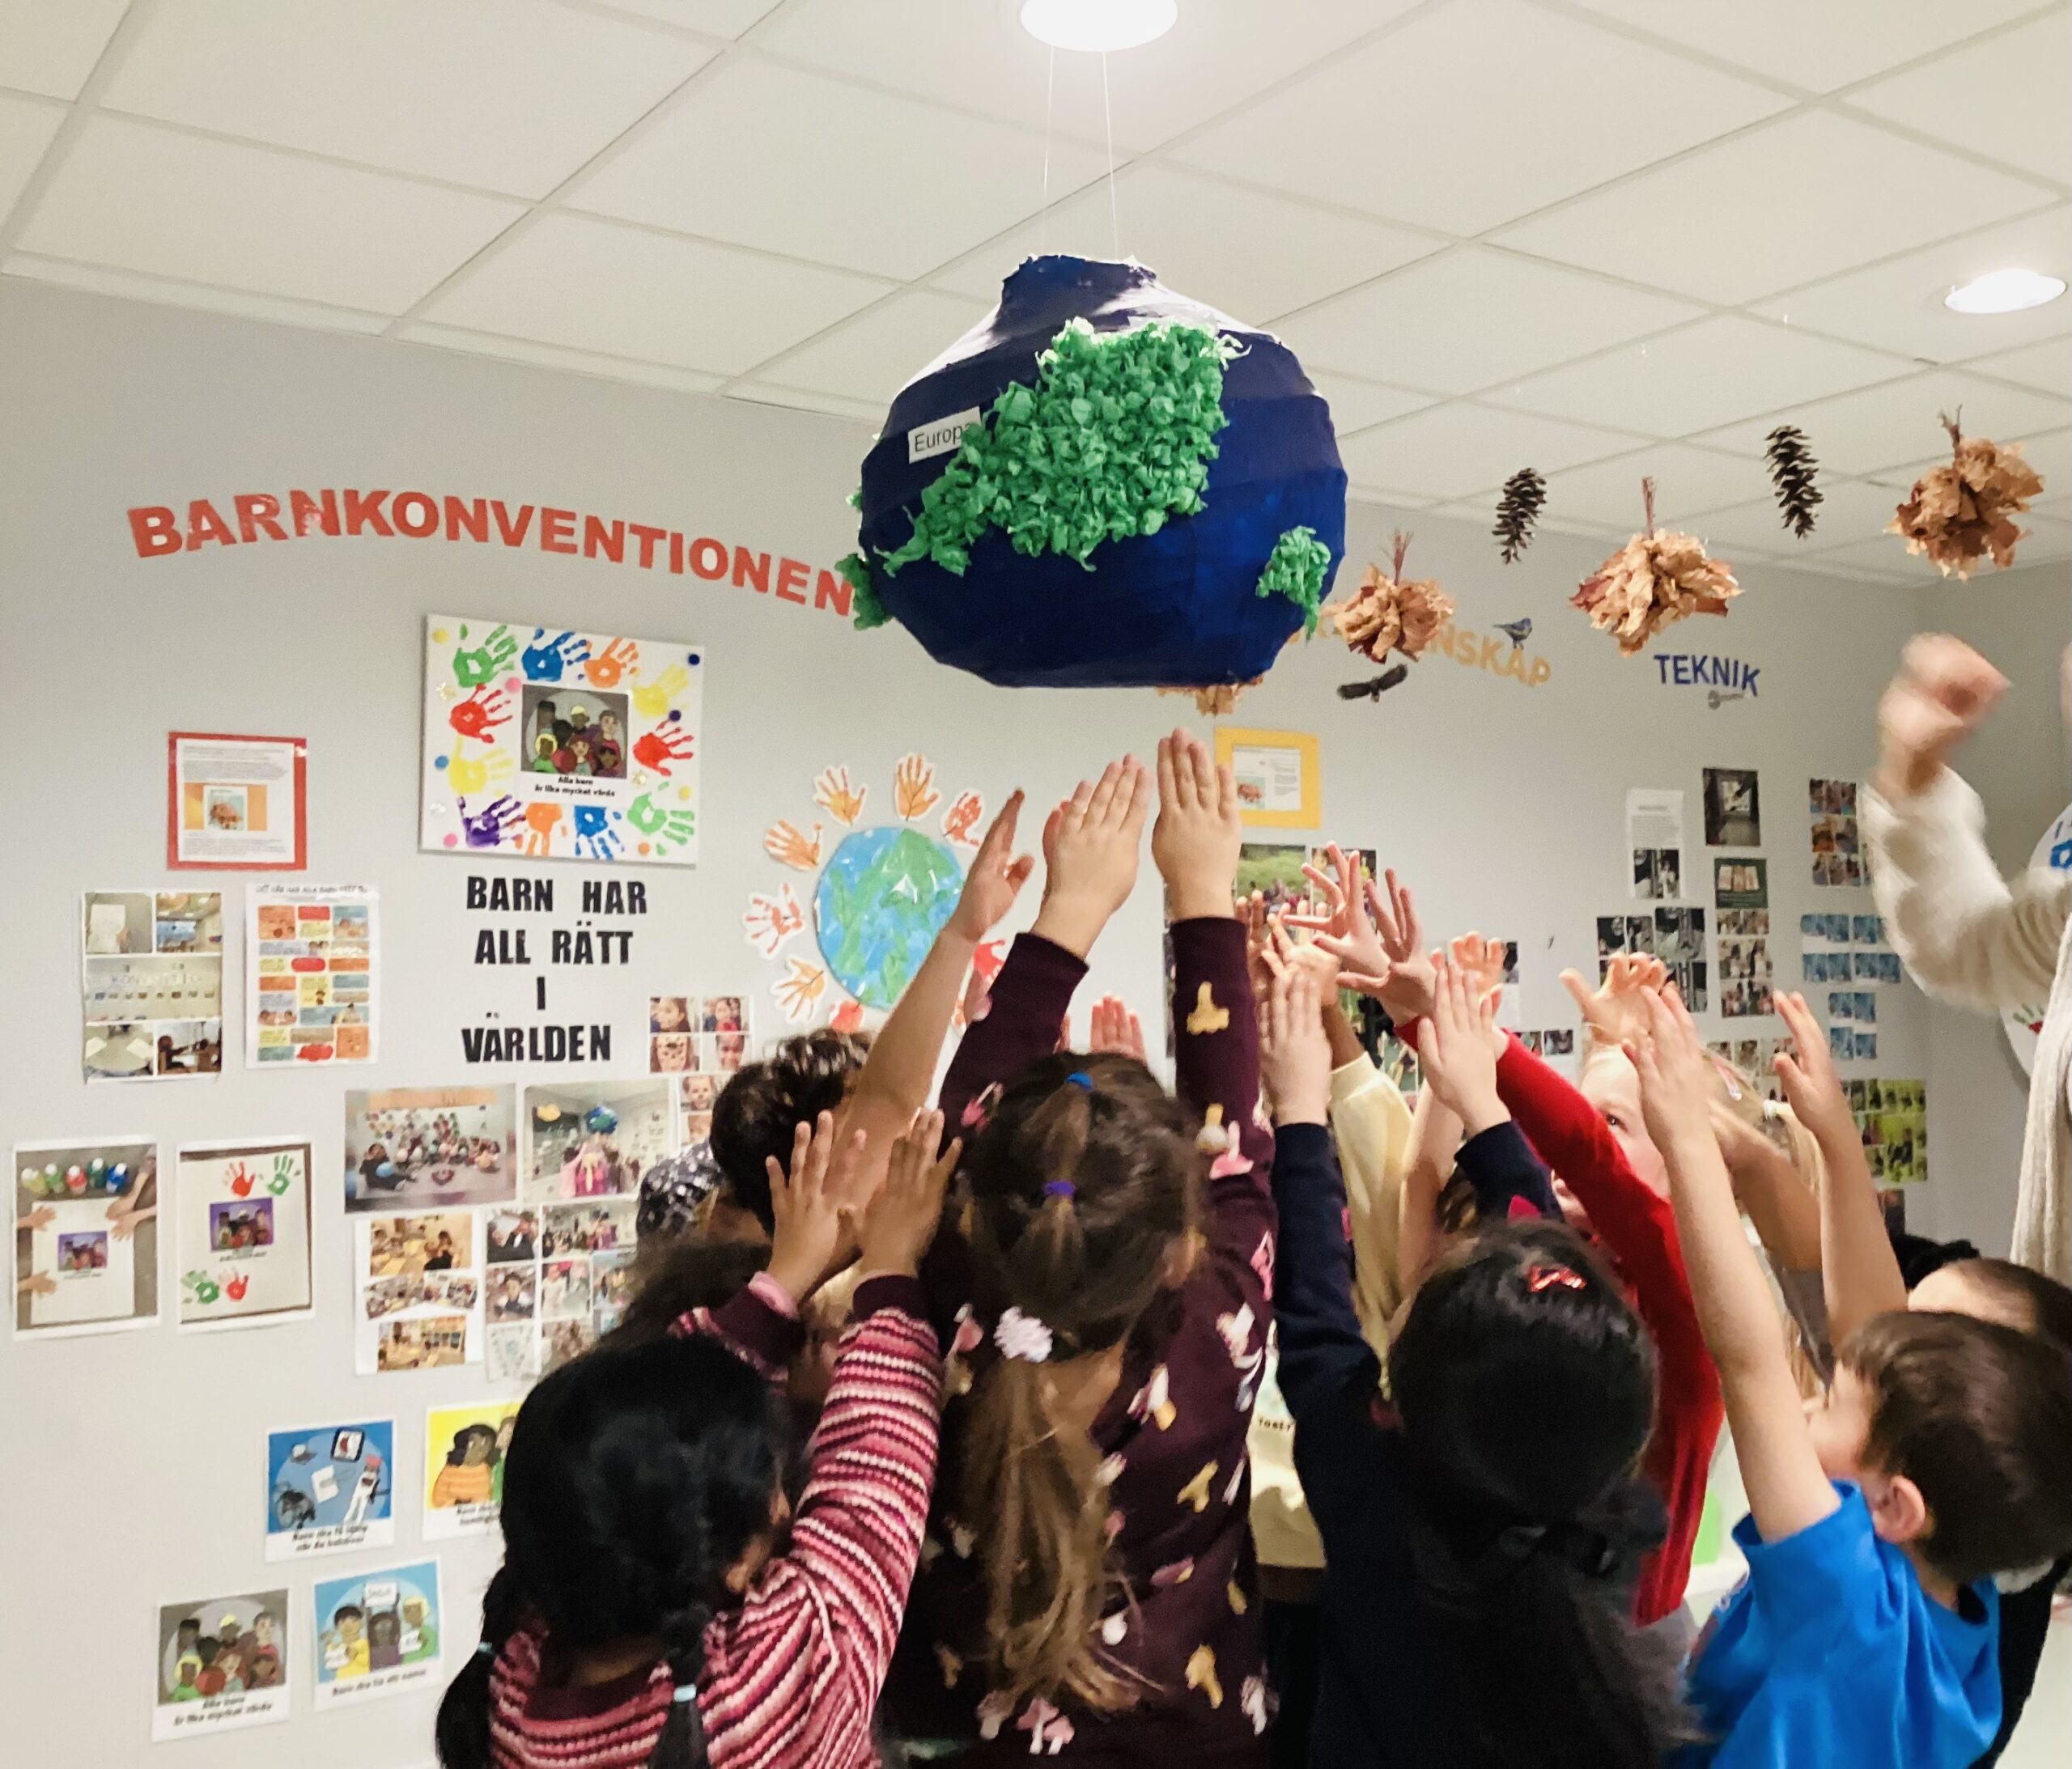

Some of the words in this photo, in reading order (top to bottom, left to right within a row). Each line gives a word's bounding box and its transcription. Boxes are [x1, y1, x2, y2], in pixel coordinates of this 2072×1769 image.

[128, 489, 854, 617] BARNKONVENTIONEN
[1654, 654, 1760, 697] TEKNIK
[467, 876, 553, 912] BARN
[582, 880, 647, 914] HAR
[474, 929, 531, 965] ALL
[551, 920, 634, 965] RÄTT
[537, 976, 546, 1010] I
[461, 1012, 611, 1063] VÄRLDEN
